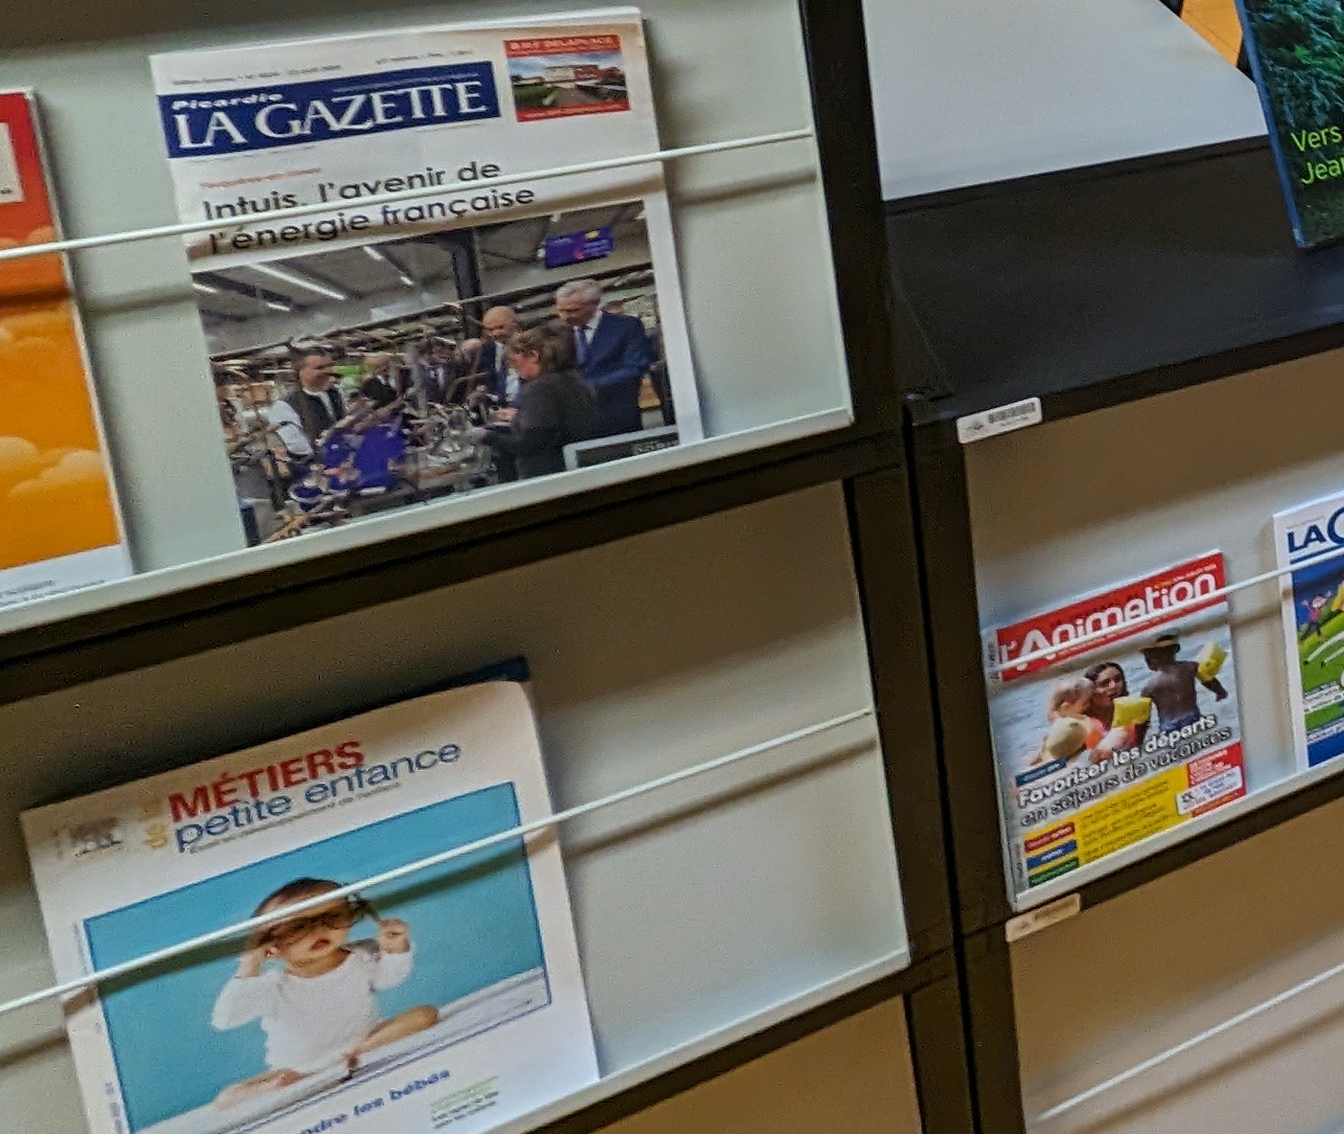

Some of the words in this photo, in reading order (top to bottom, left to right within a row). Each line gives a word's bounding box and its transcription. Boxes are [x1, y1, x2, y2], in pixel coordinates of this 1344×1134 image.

[171, 93, 284, 111] Picardie
[175, 112, 248, 150] LA
[255, 81, 488, 138] GAZETTE
[1290, 124, 1343, 153] Vers
[318, 165, 445, 204] l'avenir
[457, 160, 501, 185] de
[381, 185, 534, 223] française
[1287, 524, 1327, 552] LA
[167, 740, 365, 823] MÉTIERS
[1018, 759, 1108, 807] Favoriser
[1112, 747, 1141, 766] les
[1144, 713, 1218, 752] départs
[174, 794, 293, 853] petite
[305, 743, 461, 803] enfance
